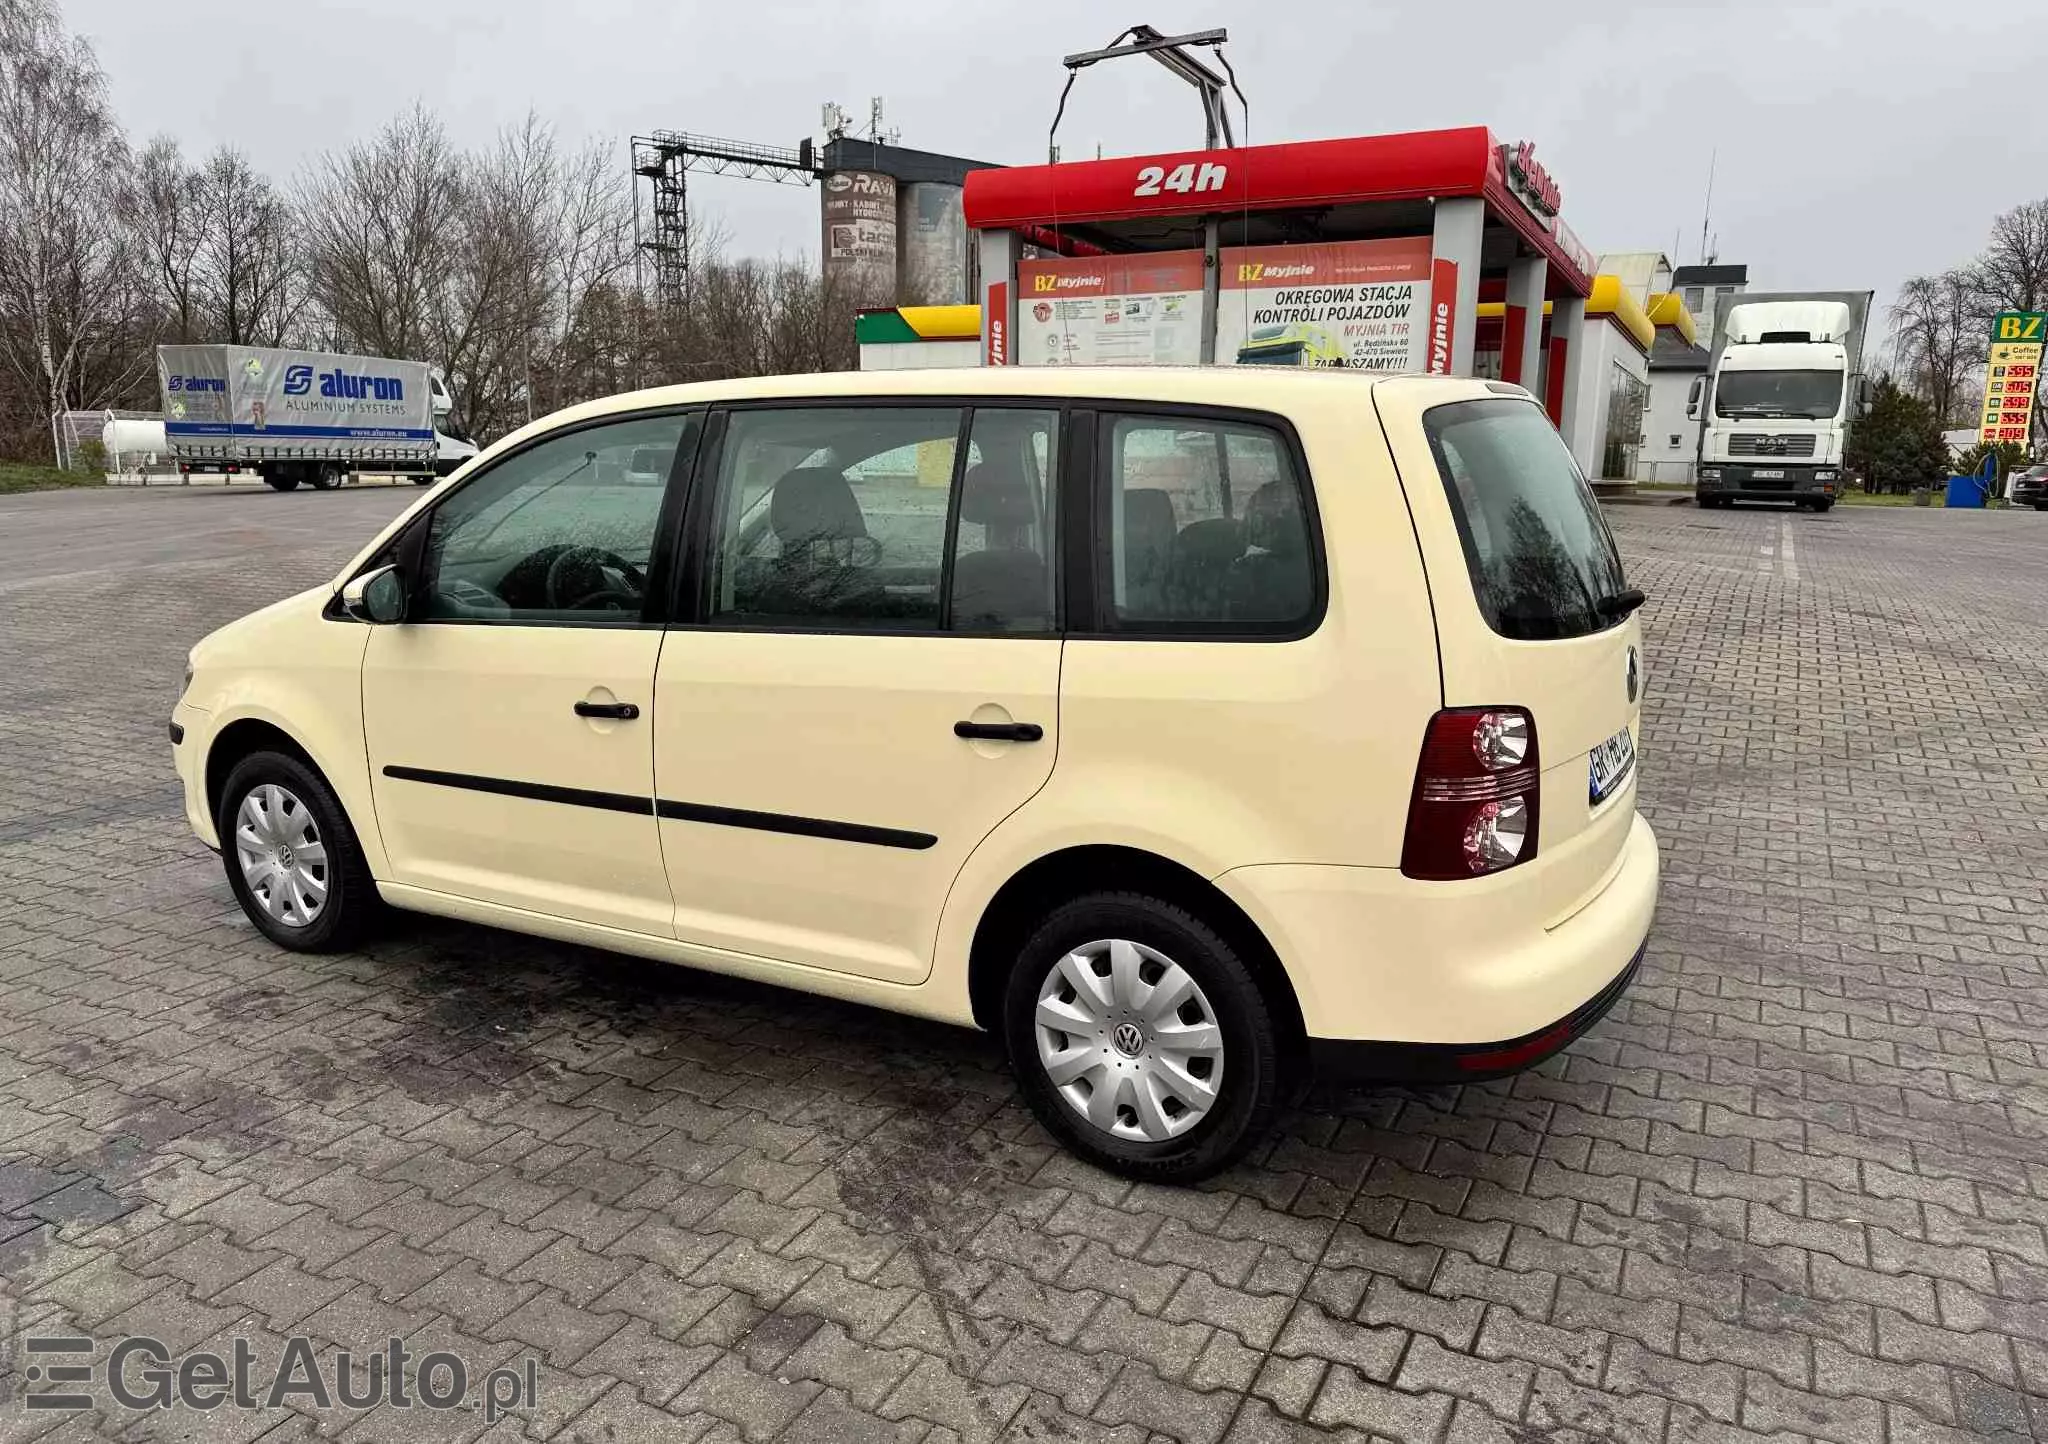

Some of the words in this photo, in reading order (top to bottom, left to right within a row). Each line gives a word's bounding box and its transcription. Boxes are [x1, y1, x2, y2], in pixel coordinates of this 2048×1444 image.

[1134, 162, 1227, 197] 24h
[1239, 263, 1264, 282] BZ
[1264, 264, 1315, 278] Myjnie
[1034, 274, 1057, 292] BZ
[1057, 276, 1101, 288] Myjnie
[1275, 288, 1354, 308] OKRĘGOWA
[1360, 285, 1412, 301] STACJA
[1253, 307, 1323, 324] KONTROLI
[1327, 302, 1410, 321] POJAZDÓW
[1344, 323, 1389, 337] MYJNIA
[1392, 322, 1410, 335] TIR
[1999, 316, 2042, 338] BZ
[1314, 357, 1408, 369] ZAPASZAMY!!!
[185, 375, 226, 393] aluron
[319, 367, 404, 401] aluron
[286, 399, 357, 414] ALUMINIUM
[359, 401, 407, 416] SYSTEMS
